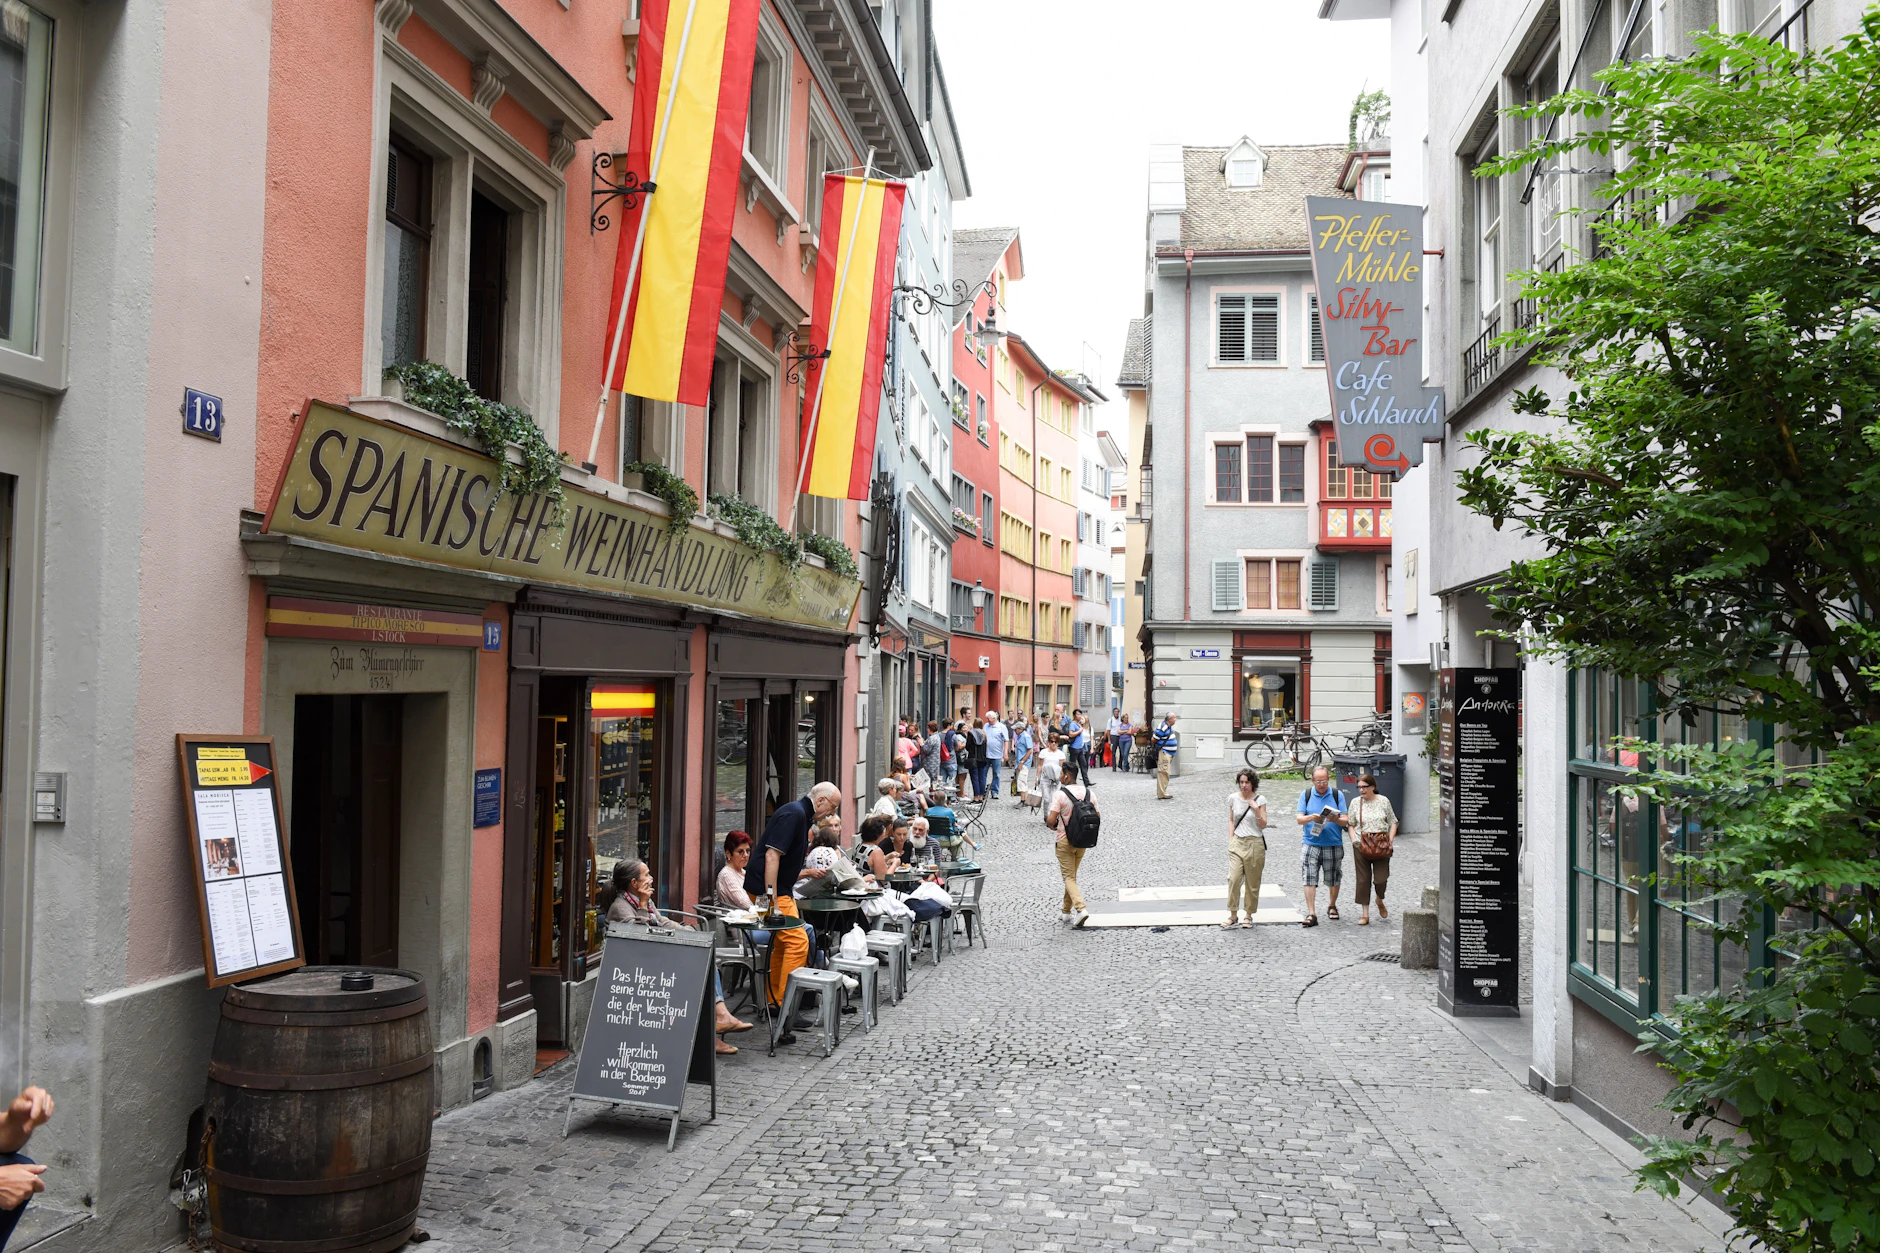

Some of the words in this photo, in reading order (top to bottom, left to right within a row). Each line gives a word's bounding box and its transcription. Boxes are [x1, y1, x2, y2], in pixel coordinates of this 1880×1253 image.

[1314, 214, 1411, 253] Pfeffer-
[1335, 251, 1419, 284] Mühle
[1326, 287, 1404, 325] Silvy-
[1360, 325, 1417, 357] Bar
[1335, 360, 1392, 395] Cafe
[193, 396, 217, 432] 13
[1340, 395, 1439, 425] Schlauch
[291, 428, 558, 566] SPANISCHE
[563, 504, 754, 603] WEINHANDLUNG
[357, 604, 423, 621] RESTAURANTE
[351, 616, 381, 629] TIPICO
[382, 618, 425, 632] MORESCO
[486, 626, 499, 646] 15
[370, 676, 390, 689] 1524
[1474, 676, 1498, 684] CHOPFAB
[612, 967, 631, 983] Das
[634, 967, 657, 986] Herz
[660, 971, 677, 988] hat
[610, 984, 634, 996] seine
[637, 983, 671, 999] Gründe
[607, 995, 622, 1011] die
[626, 996, 642, 1012] der
[646, 998, 688, 1018] Verstand
[606, 1010, 634, 1026] nicht
[617, 1041, 658, 1060] Herzlich
[607, 1056, 665, 1073] willkommen
[600, 1069, 609, 1079] in
[611, 1067, 627, 1080] der
[630, 1068, 667, 1090] Bodega
